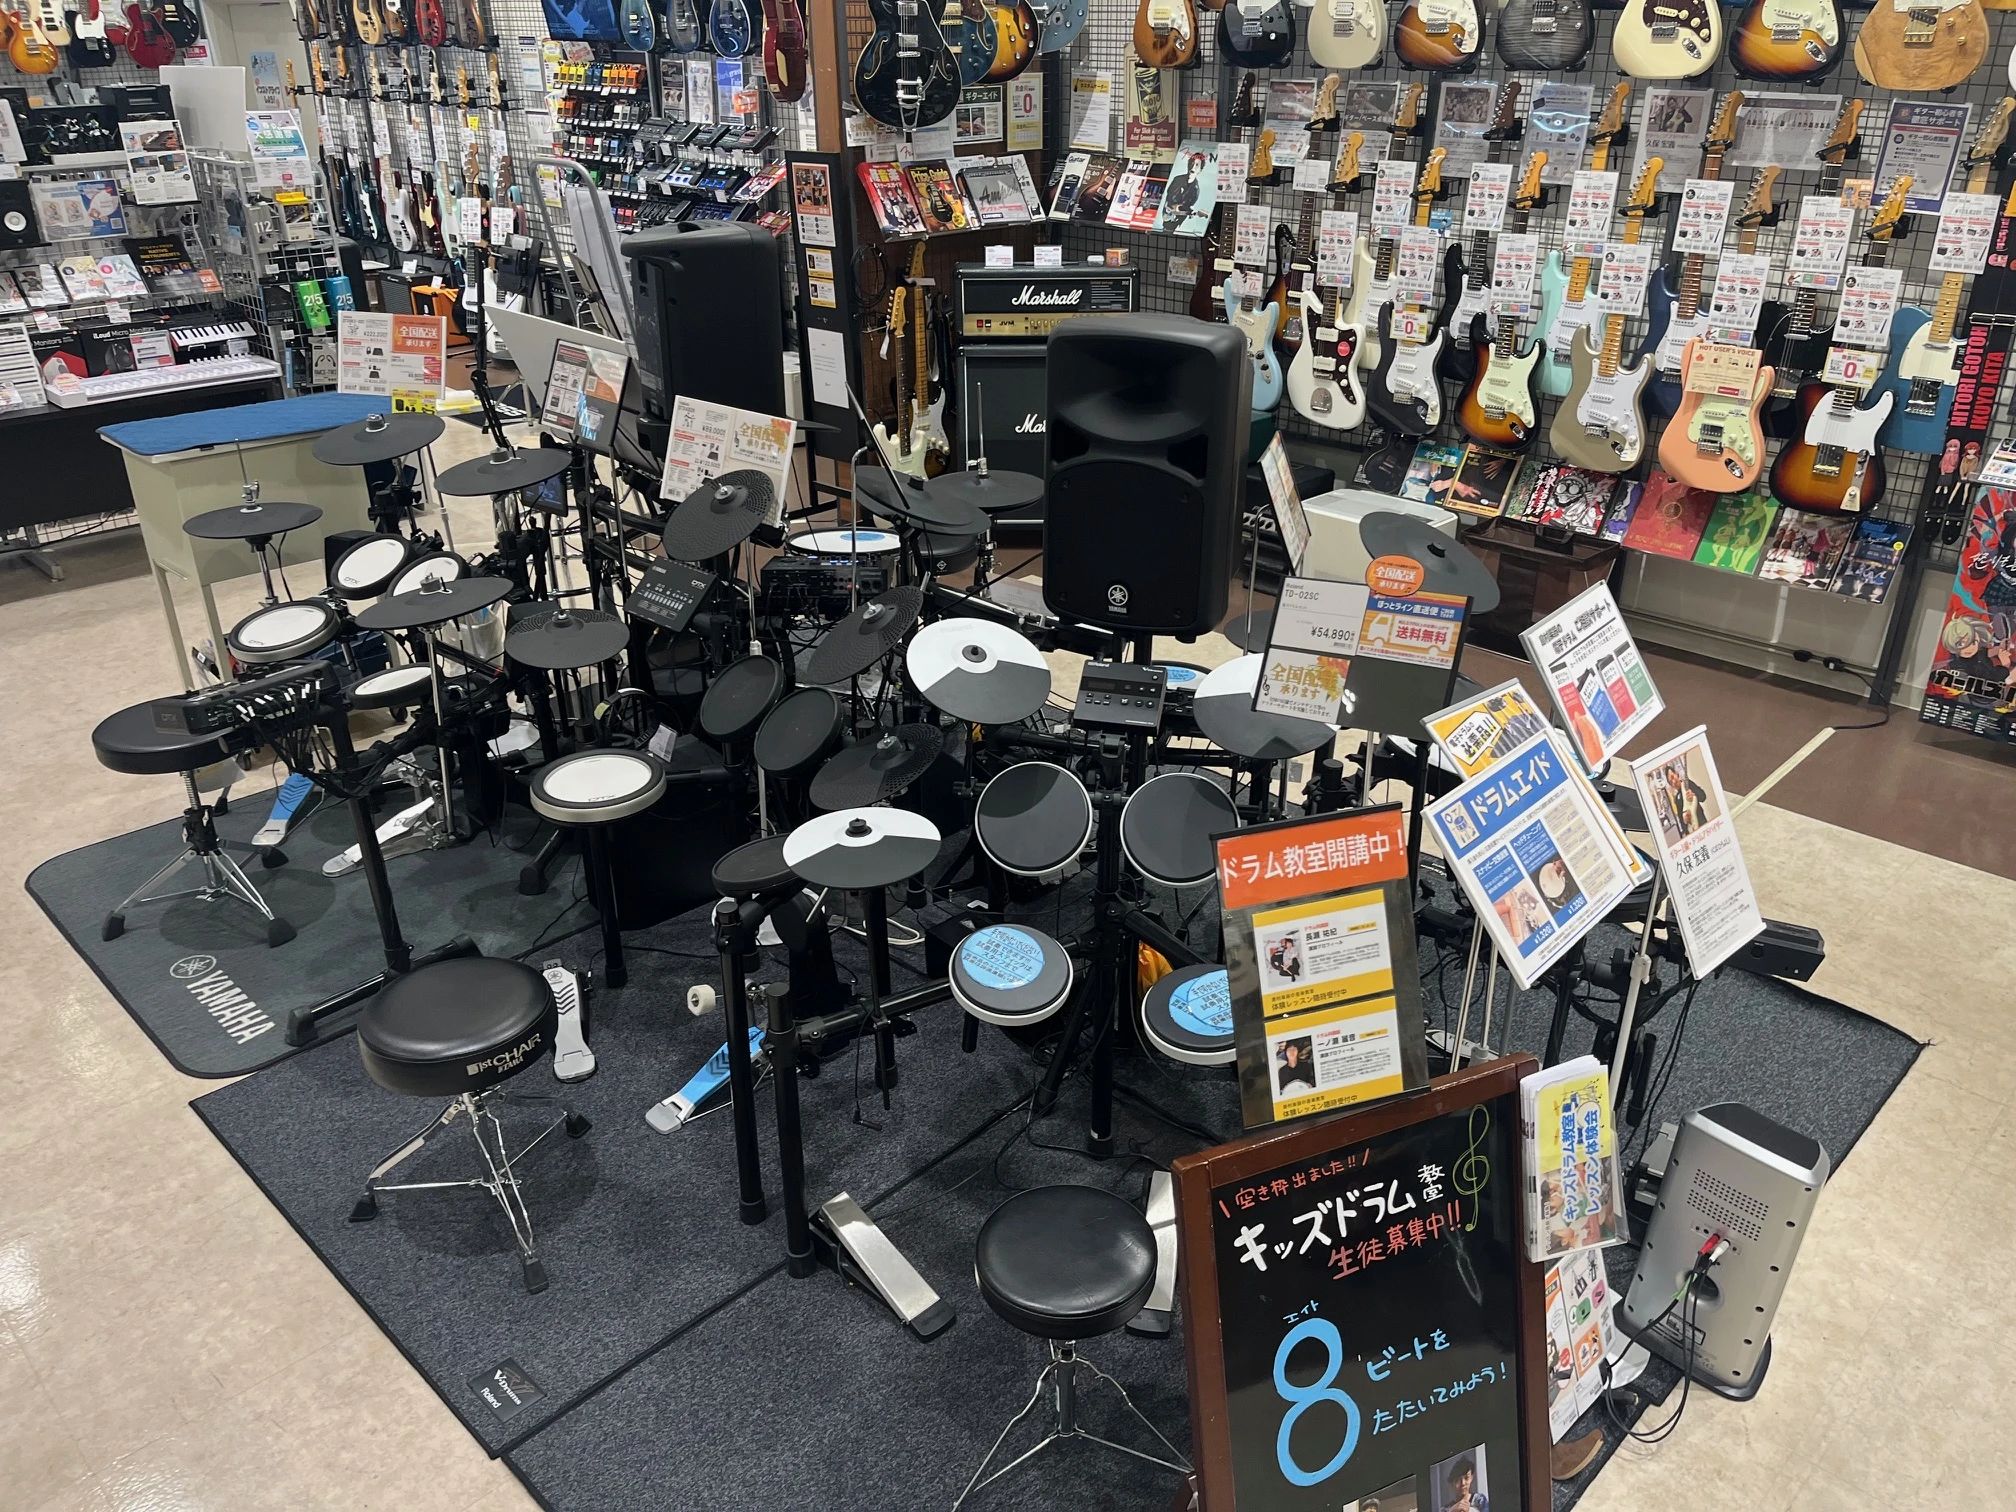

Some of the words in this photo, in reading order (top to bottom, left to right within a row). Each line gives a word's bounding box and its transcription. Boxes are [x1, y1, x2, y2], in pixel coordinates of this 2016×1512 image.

[254, 221, 272, 234] 112
[303, 293, 323, 307] 215
[335, 294, 353, 307] 215
[1011, 285, 1083, 306] Marshall
[33, 337, 63, 347] Monitors
[400, 326, 438, 338] 全国配送
[1950, 378, 1972, 428] HITORI
[1966, 326, 1988, 375] GOTOH
[1980, 351, 2006, 386] KITA
[1969, 386, 1995, 430] IKUYO
[1375, 566, 1416, 581] 全国配送
[1284, 588, 1319, 601] TD-02SC
[1311, 626, 1350, 641] ¥54,890
[1395, 627, 1448, 645] 送料無料
[1279, 684, 1320, 700] 承ります
[1470, 751, 1551, 827] ドラムエイド
[1221, 829, 1405, 889] ドラム教室開講中!
[1676, 855, 1693, 879] 久保
[186, 969, 276, 1046] YAMAHA
[492, 1033, 542, 1067] CHAIR
[1562, 1112, 1577, 1222] キッズドラム教室
[1584, 1108, 1601, 1215] レッスン体験会
[1233, 1179, 1416, 1272] キッズドラム
[1417, 1164, 1446, 1203] 教室
[1328, 1200, 1462, 1280] 生徒募集中!!
[1283, 1300, 1320, 1323] エイト
[1366, 1329, 1450, 1382] ビートを
[480, 1387, 502, 1409] Roland
[1273, 1317, 1361, 1487] 8
[1372, 1362, 1508, 1436] たたいてみよう!
